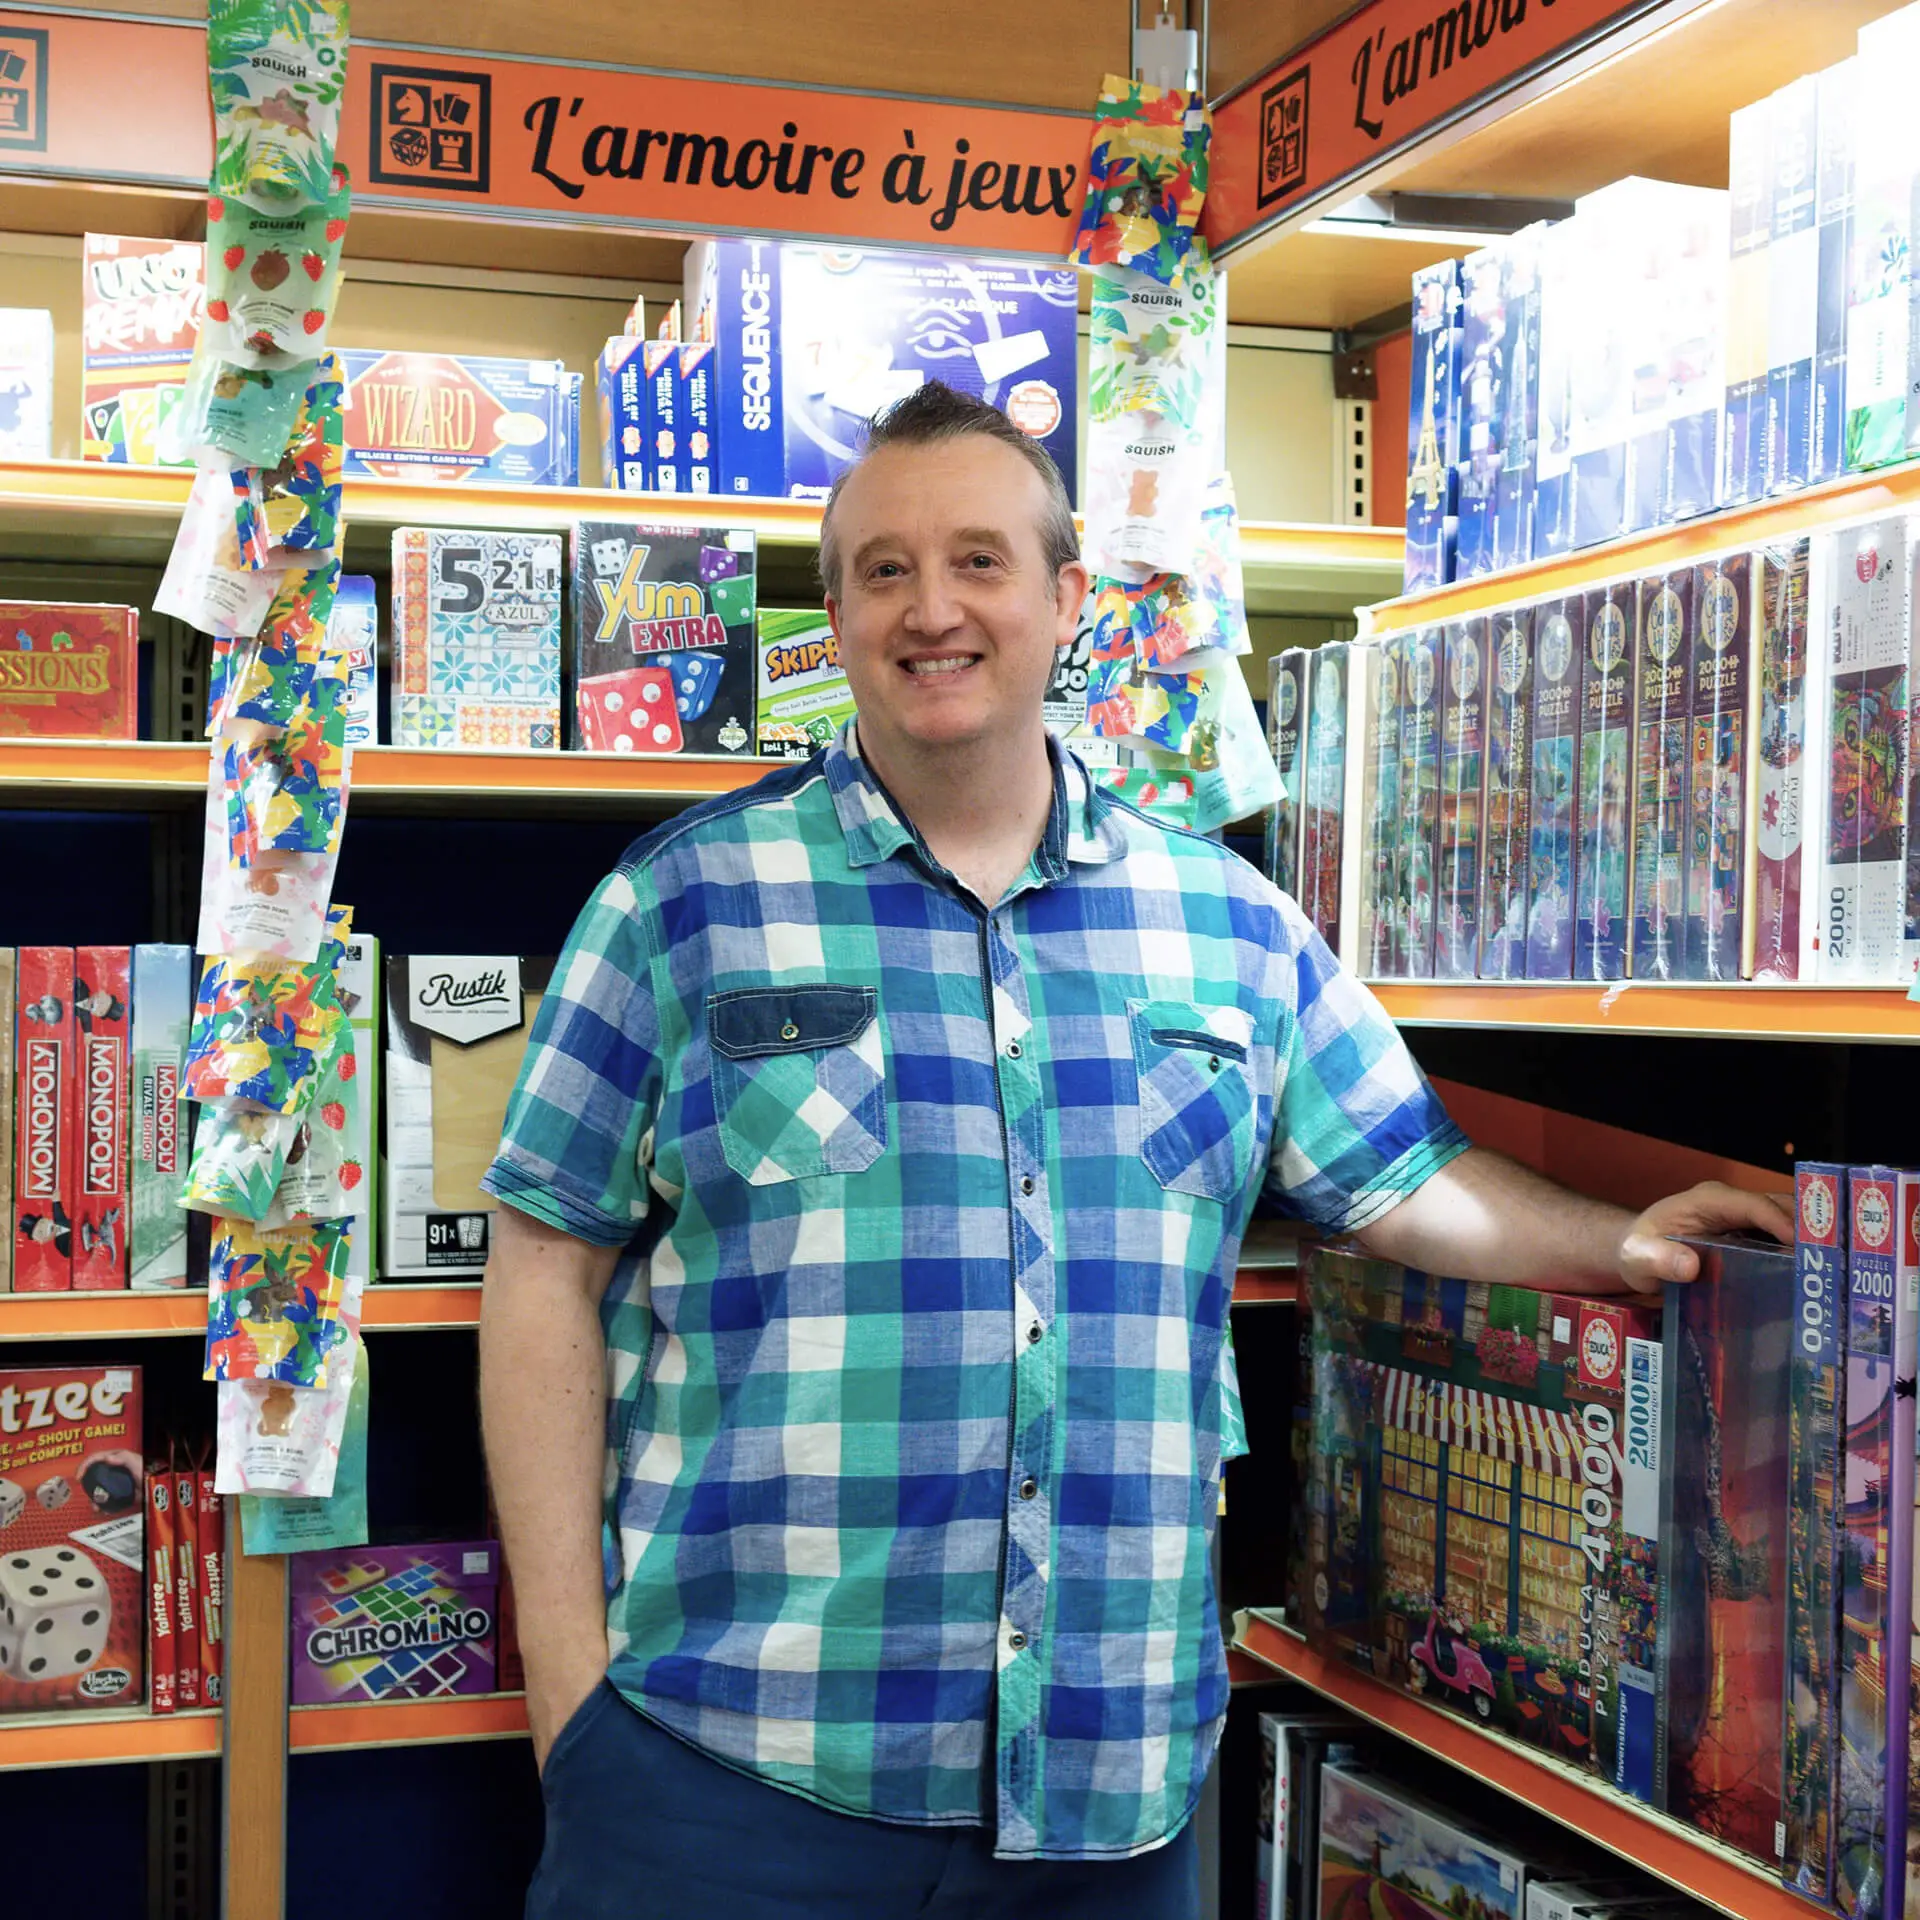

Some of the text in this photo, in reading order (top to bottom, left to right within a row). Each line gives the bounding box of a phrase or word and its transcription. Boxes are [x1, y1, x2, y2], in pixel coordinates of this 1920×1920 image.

[251, 56, 307, 79] SQUISH
[523, 96, 1077, 232] L'armoire à jeux
[1131, 292, 1183, 309] SQUISH
[741, 269, 772, 431] SEQUENCE
[362, 383, 477, 452] WIZARD
[355, 451, 485, 466] DELUXE EDITION CARD GAME
[1125, 444, 1175, 457] SQUISH
[495, 607, 540, 620] AZUL
[595, 545, 706, 642] Yum
[630, 614, 728, 655] EXTRA
[1644, 668, 1672, 685] 2000
[1698, 657, 1726, 675] 2000
[1699, 671, 1737, 691] PUZZLE
[1588, 679, 1614, 695] 200
[1645, 680, 1681, 700] PUZZLE
[1448, 705, 1471, 720] 200
[1448, 718, 1478, 734] PUZLE
[1539, 701, 1570, 716] PUZZLE
[763, 741, 783, 753] ROLL
[784, 747, 810, 758] WRITE
[1789, 777, 1799, 840] PUZZLE
[1829, 886, 1846, 958] 2000
[419, 969, 511, 1007] Rustik
[31, 1044, 57, 1192] MONOPOLY
[88, 1043, 115, 1191] MONOPOLY
[142, 1077, 153, 1161] RIVALS EDITION
[157, 1067, 175, 1172] MONOPOLY
[429, 1223, 448, 1244] 91
[1851, 1269, 1894, 1299] 2000
[1856, 1261, 1890, 1272] PUZZLE
[1802, 1248, 1825, 1354] 2000
[1823, 1262, 1834, 1346] PUZZLE
[1409, 1386, 1592, 1463] BOOKSHOP
[1629, 1383, 1650, 1469] 2000
[1648, 1346, 1658, 1471] Ravensburger Puzzle
[29, 1441, 84, 1465] COMPTE!
[37, 1427, 81, 1447] SHOUT
[85, 1423, 126, 1438] GAME!
[1580, 1402, 1615, 1573] 4000
[204, 1551, 221, 1606] Yahtzee
[153, 1582, 172, 1638] Yahtzee
[178, 1577, 196, 1632] Yahtzee
[1578, 1584, 1593, 1699] EDUCA
[1595, 1588, 1611, 1717] PUZZLE
[86, 1671, 127, 1686] Hasbro
[1616, 1689, 1628, 1783] Ravensburger
